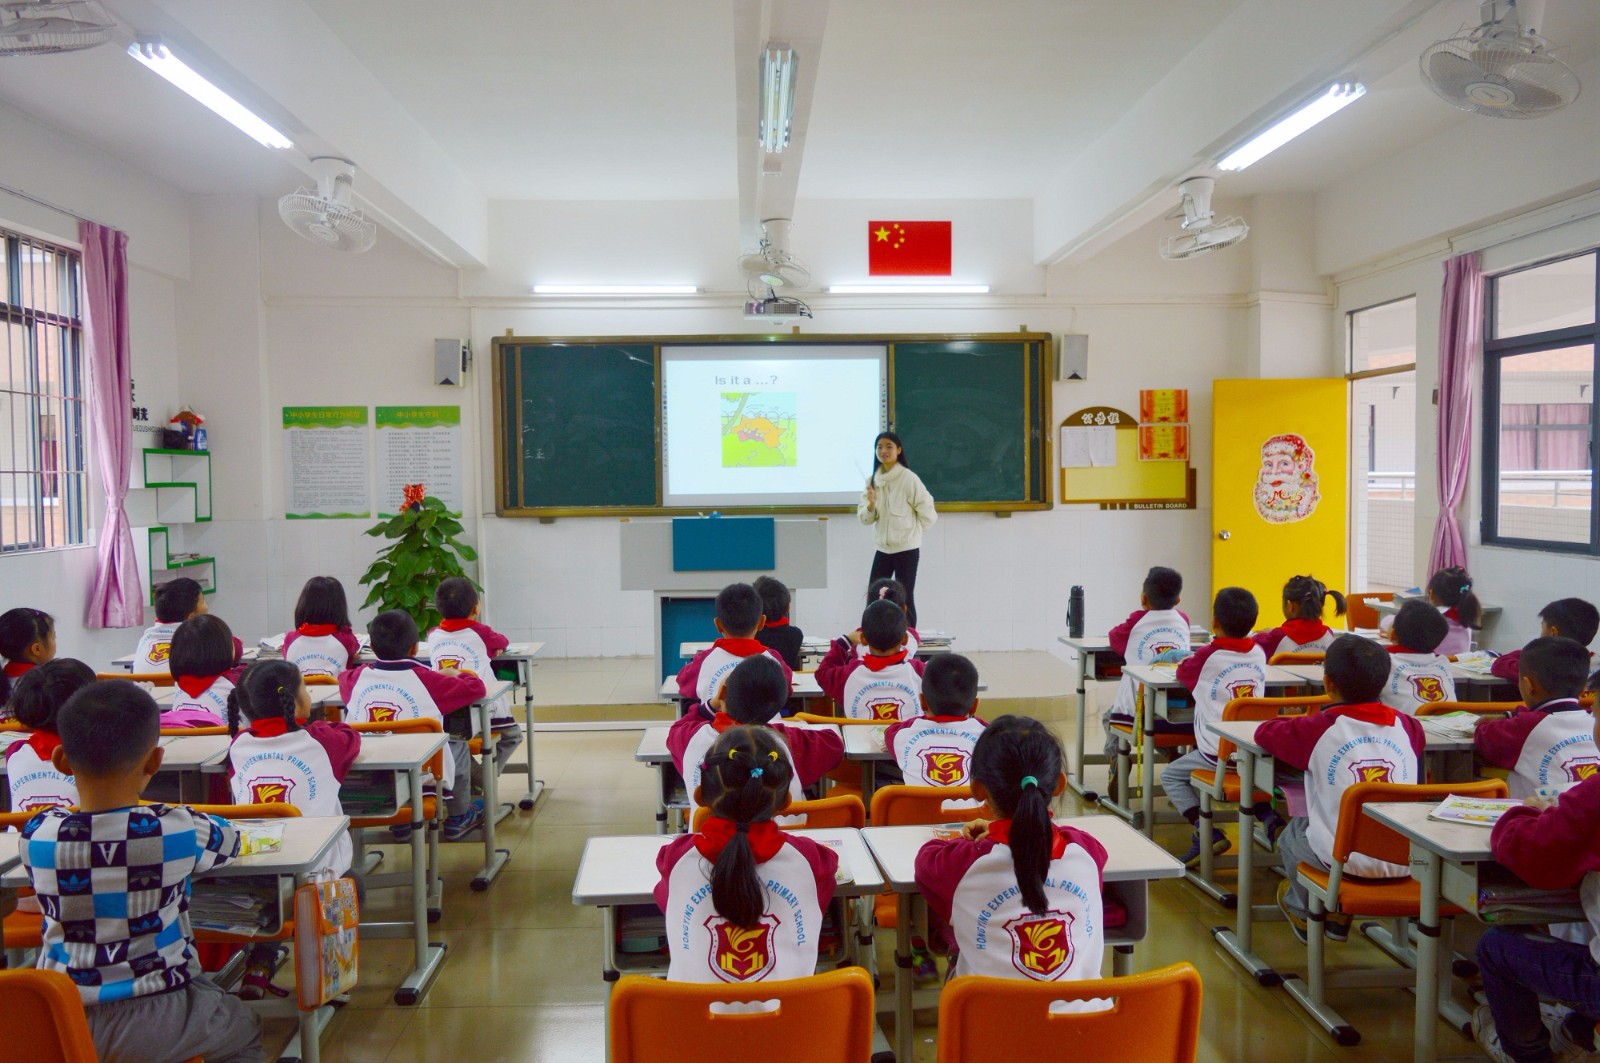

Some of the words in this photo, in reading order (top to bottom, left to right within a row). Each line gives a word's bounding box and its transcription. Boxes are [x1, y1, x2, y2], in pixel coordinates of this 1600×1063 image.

[715, 375, 726, 385] Is
[731, 375, 739, 385] it
[743, 377, 751, 385] a
[1133, 502, 1164, 510] BULLETIN
[1165, 502, 1188, 510] BOARD
[714, 661, 740, 678] EXPERIM
[858, 680, 894, 696] EXPERIMENTAL
[908, 727, 958, 746] EXPERIMENTAL
[960, 730, 977, 744] PRIM
[1327, 754, 1342, 786] HONGYING
[1337, 735, 1382, 756] EXPERIMENTAL
[1538, 754, 1552, 785] HONGYING
[1548, 734, 1593, 755] EXPERIMENTA
[11, 771, 60, 792] EXPERIMENTAL
[242, 752, 285, 773] EXPERIMENTAL
[286, 754, 313, 776] PRIMARY
[306, 776, 317, 801] SCHOOL
[682, 903, 696, 950] HONGYING
[766, 879, 800, 909] PRIMARY
[793, 909, 807, 946] SCHOOL
[975, 909, 992, 950] HONGYING
[987, 877, 1056, 912] EXPERIAL
